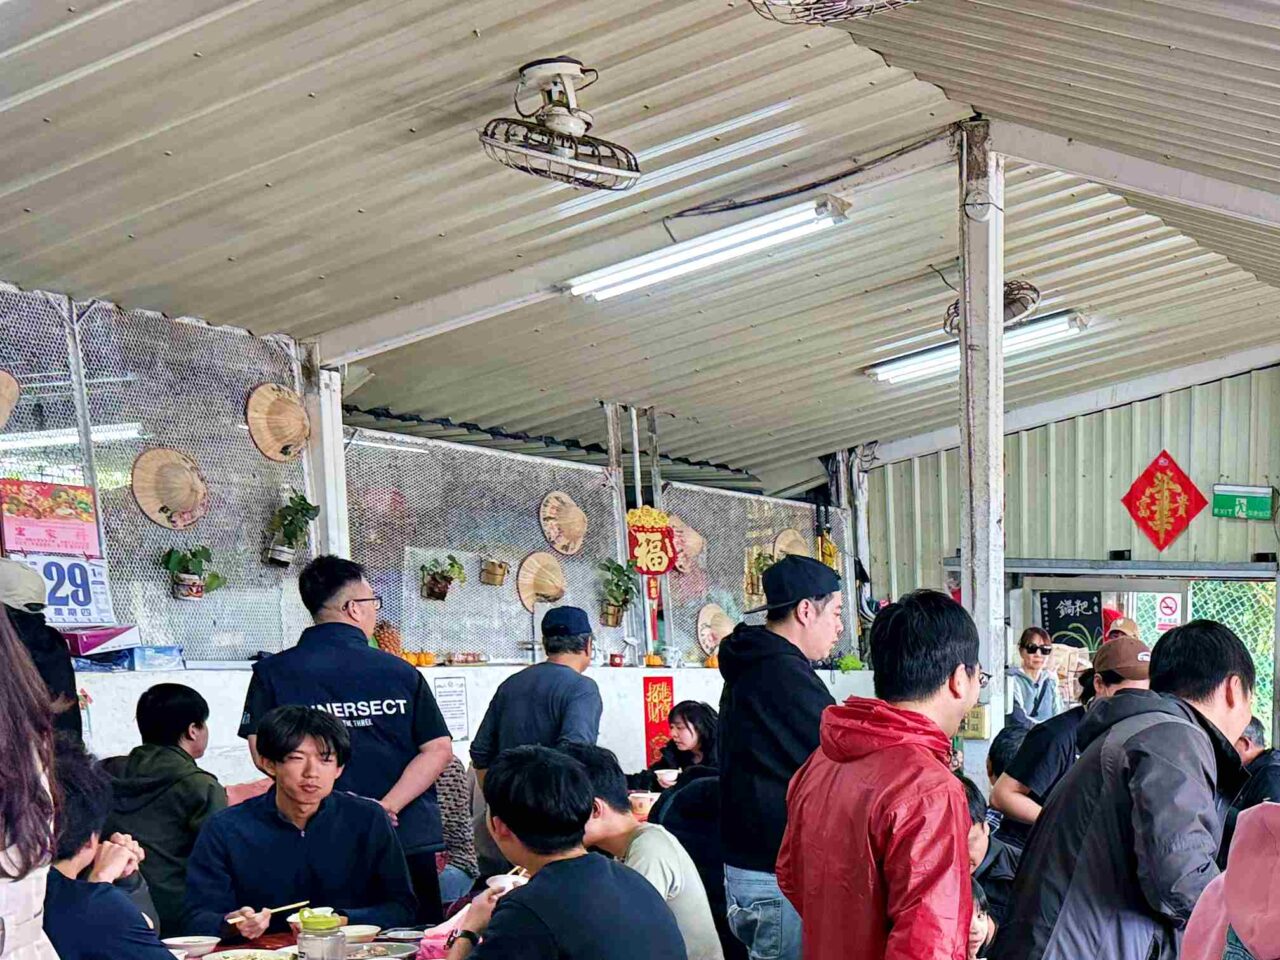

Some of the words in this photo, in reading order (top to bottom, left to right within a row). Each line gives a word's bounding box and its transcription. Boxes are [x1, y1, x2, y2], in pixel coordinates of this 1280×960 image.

[1214, 508, 1233, 516] EXIT
[634, 530, 668, 572] 福
[43, 560, 92, 607] 29
[54, 607, 92, 617] 星期四
